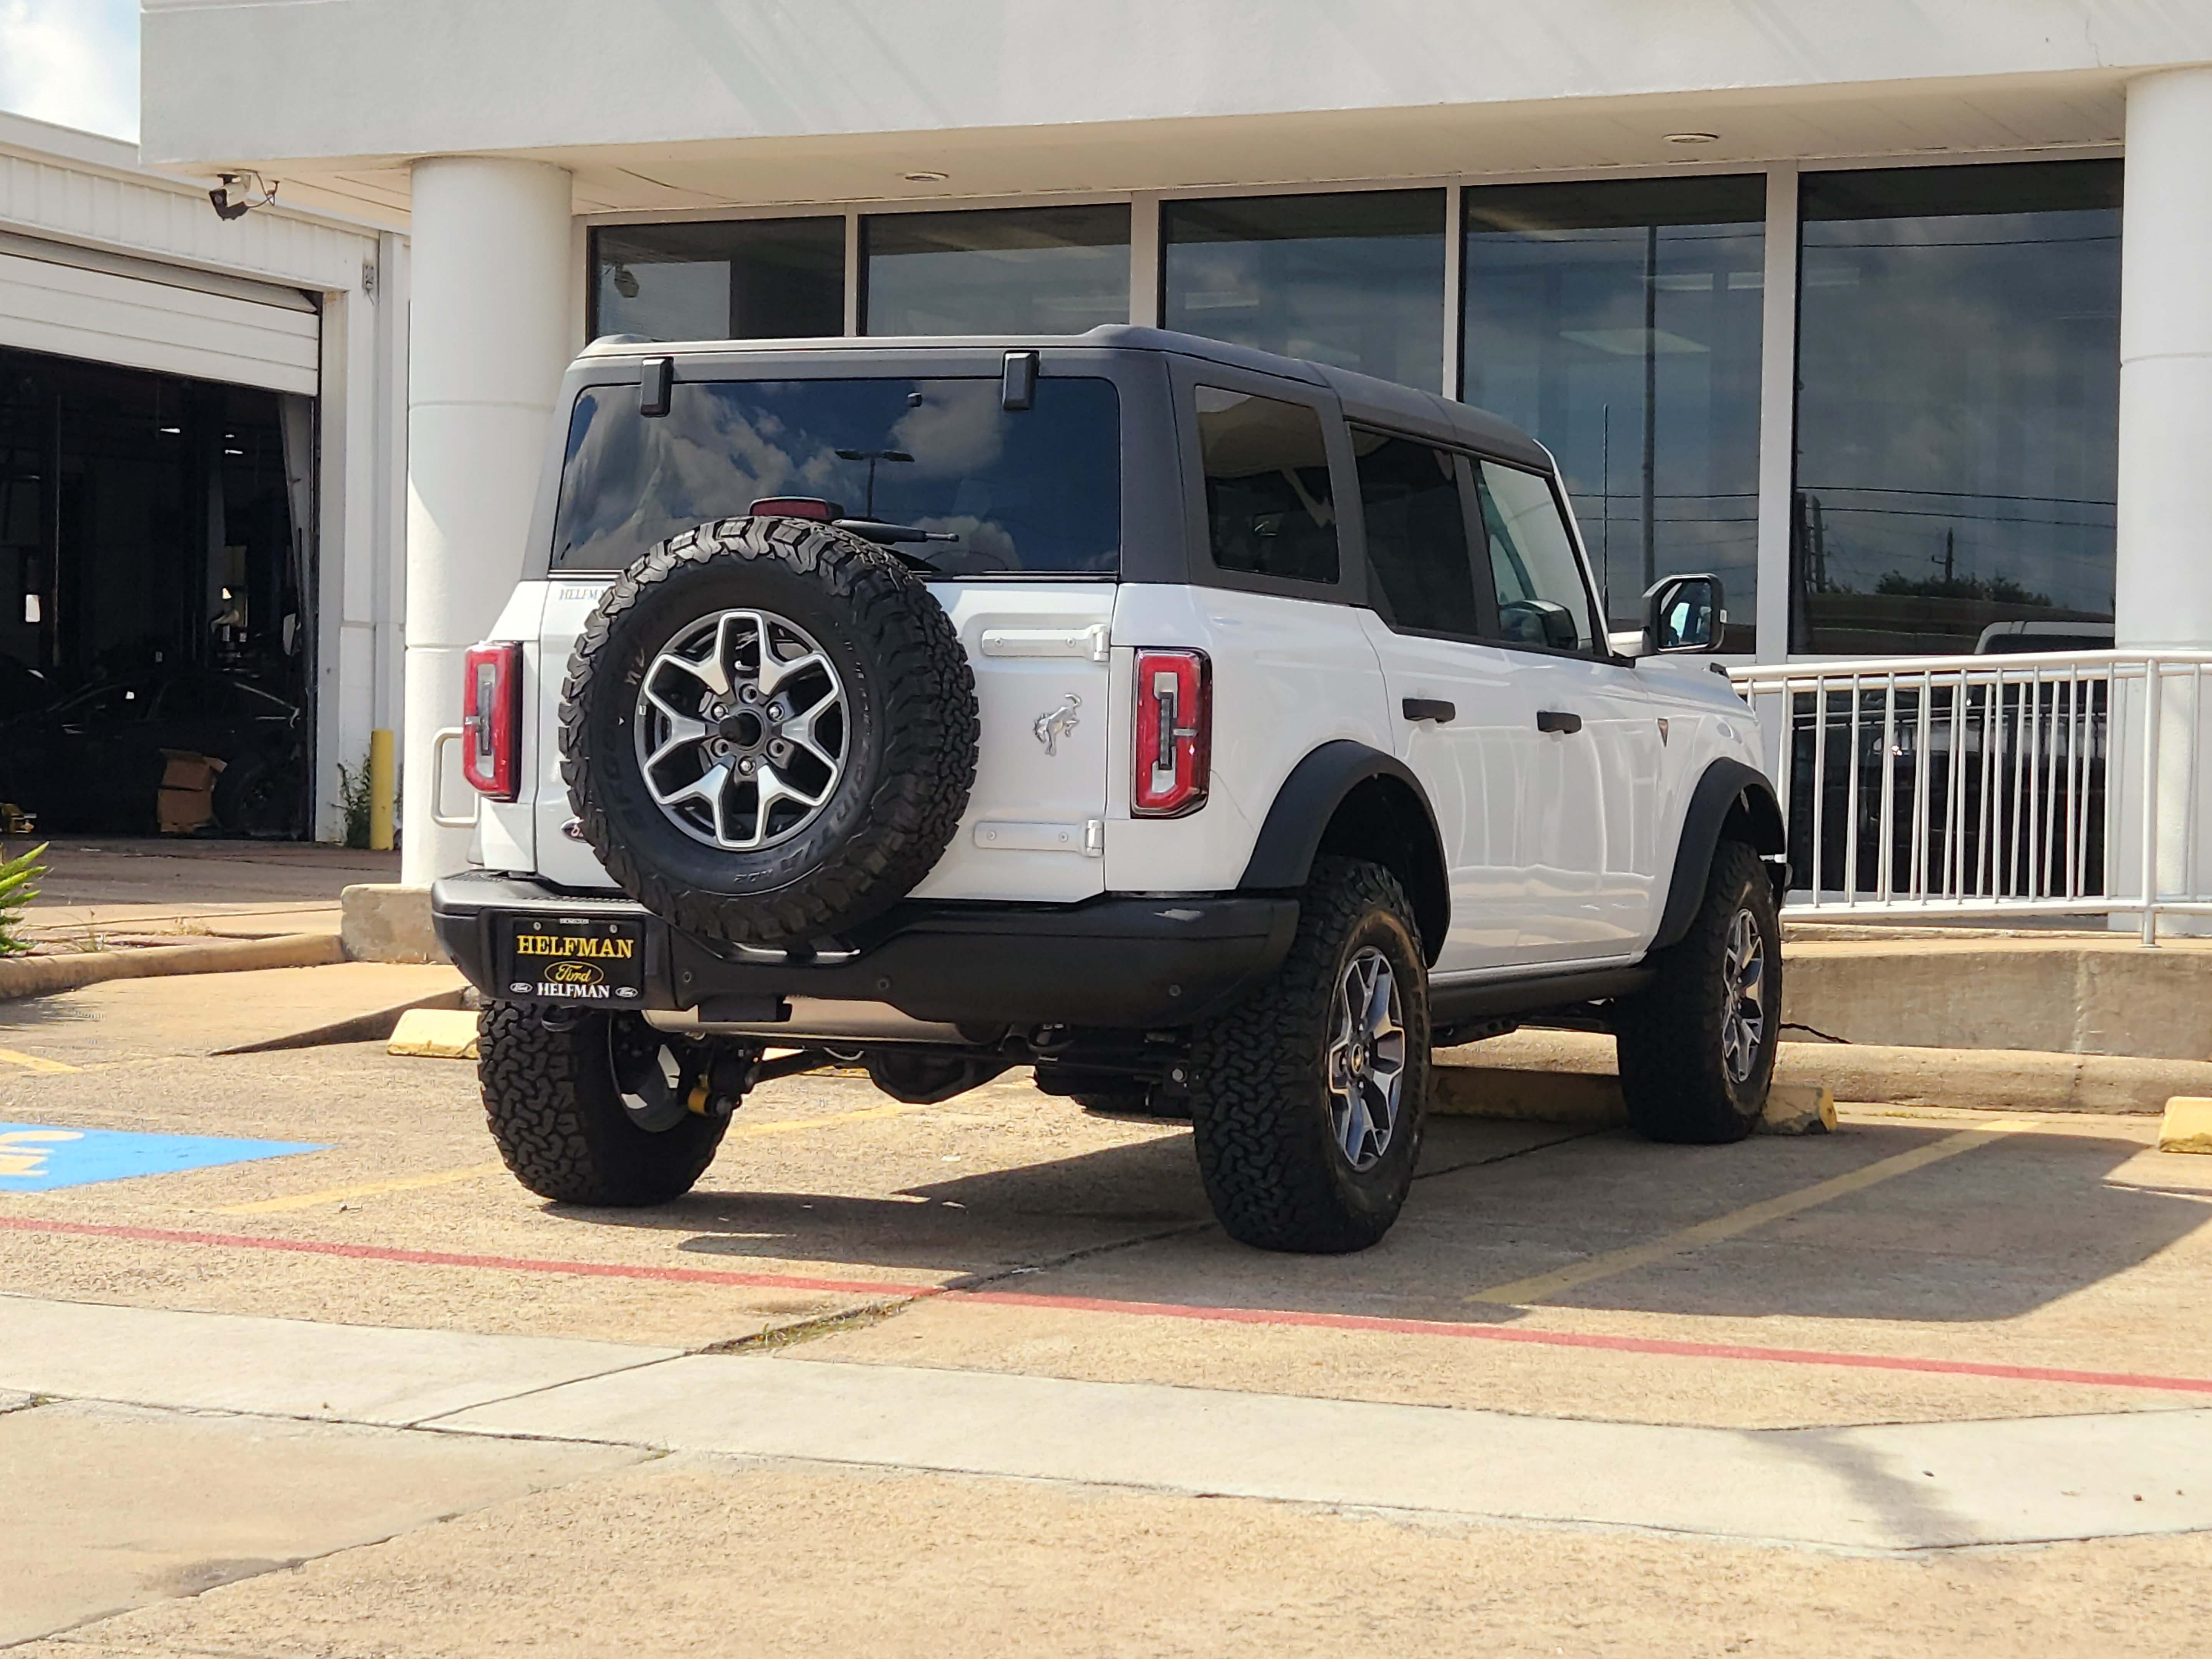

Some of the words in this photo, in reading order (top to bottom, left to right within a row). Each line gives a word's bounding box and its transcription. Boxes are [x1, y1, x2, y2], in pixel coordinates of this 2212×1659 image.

[517, 935, 634, 959] HELFMAN
[555, 964, 592, 982] Ford
[537, 982, 610, 998] HELFMAN
